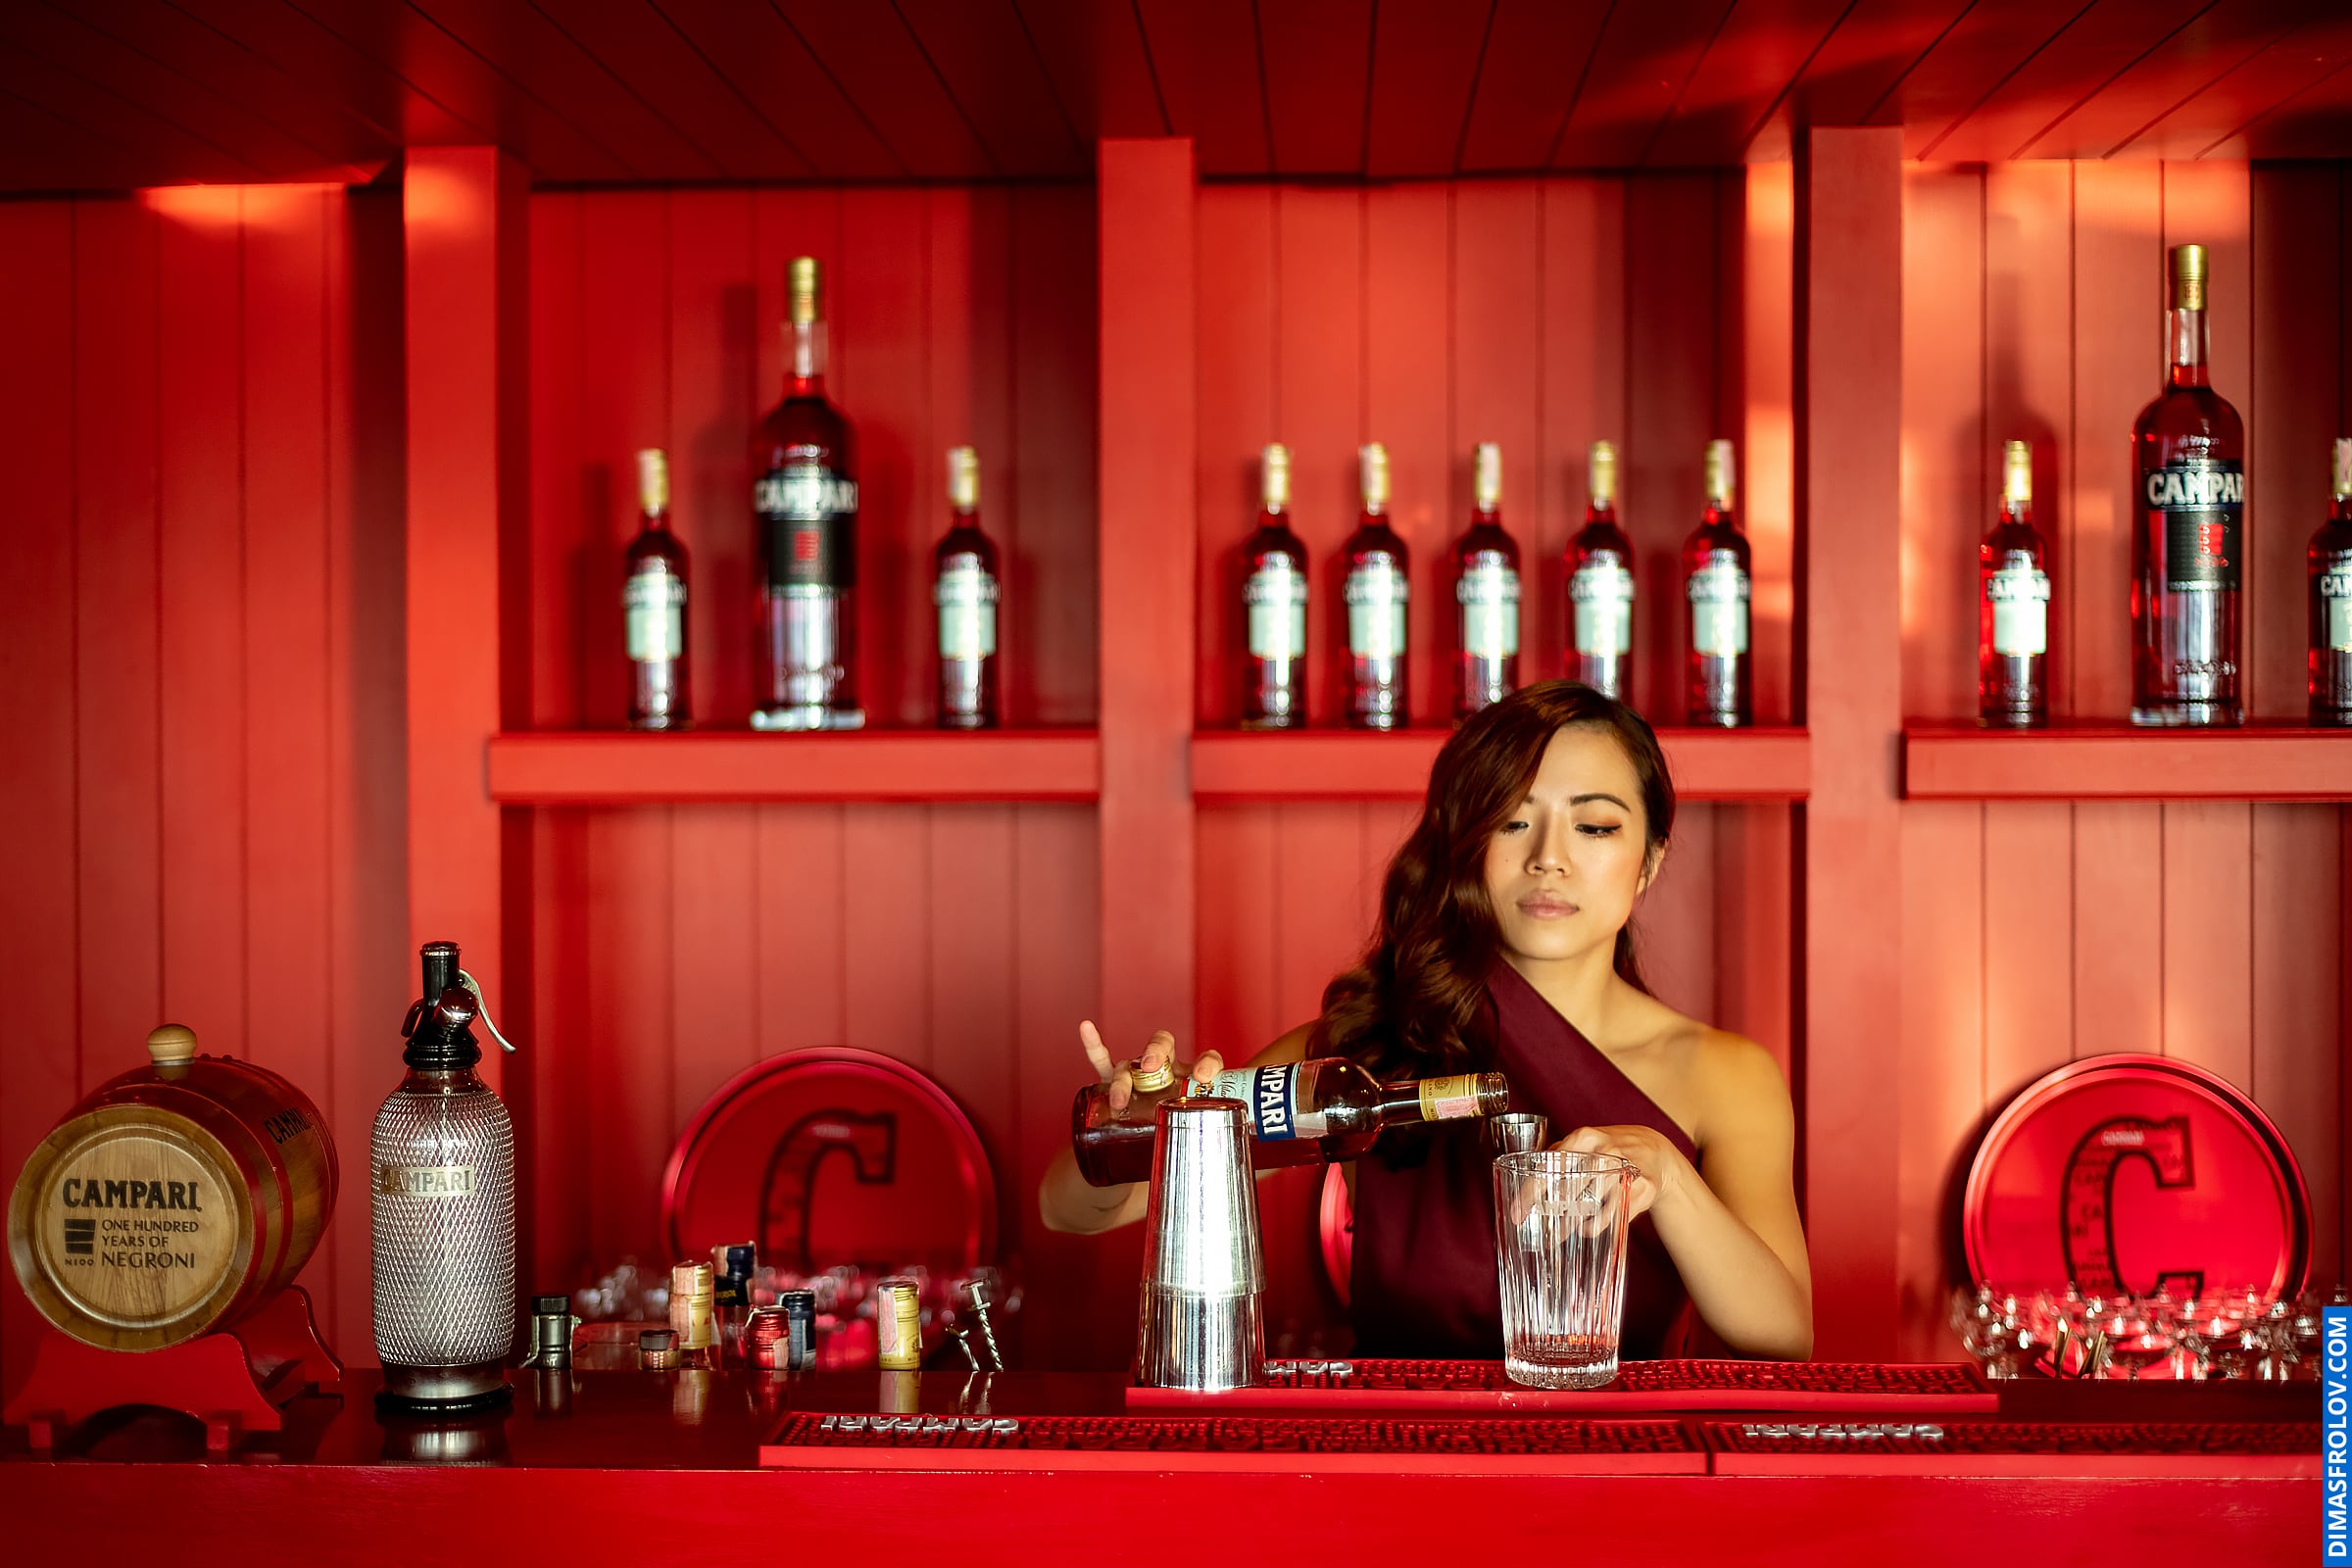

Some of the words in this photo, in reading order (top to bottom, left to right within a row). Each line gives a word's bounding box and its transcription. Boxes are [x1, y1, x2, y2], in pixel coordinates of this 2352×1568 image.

[1261, 1065, 1288, 1134] MPARI
[381, 1168, 470, 1193] CAMPARI
[63, 1178, 199, 1209] CAMPARI
[102, 1219, 129, 1231] ONE
[133, 1220, 199, 1233] HUNDRED
[102, 1236, 144, 1247] YEARS
[149, 1236, 169, 1248] OF
[102, 1251, 194, 1268] NEGRONI
[821, 1415, 1018, 1436] CAMPARI
